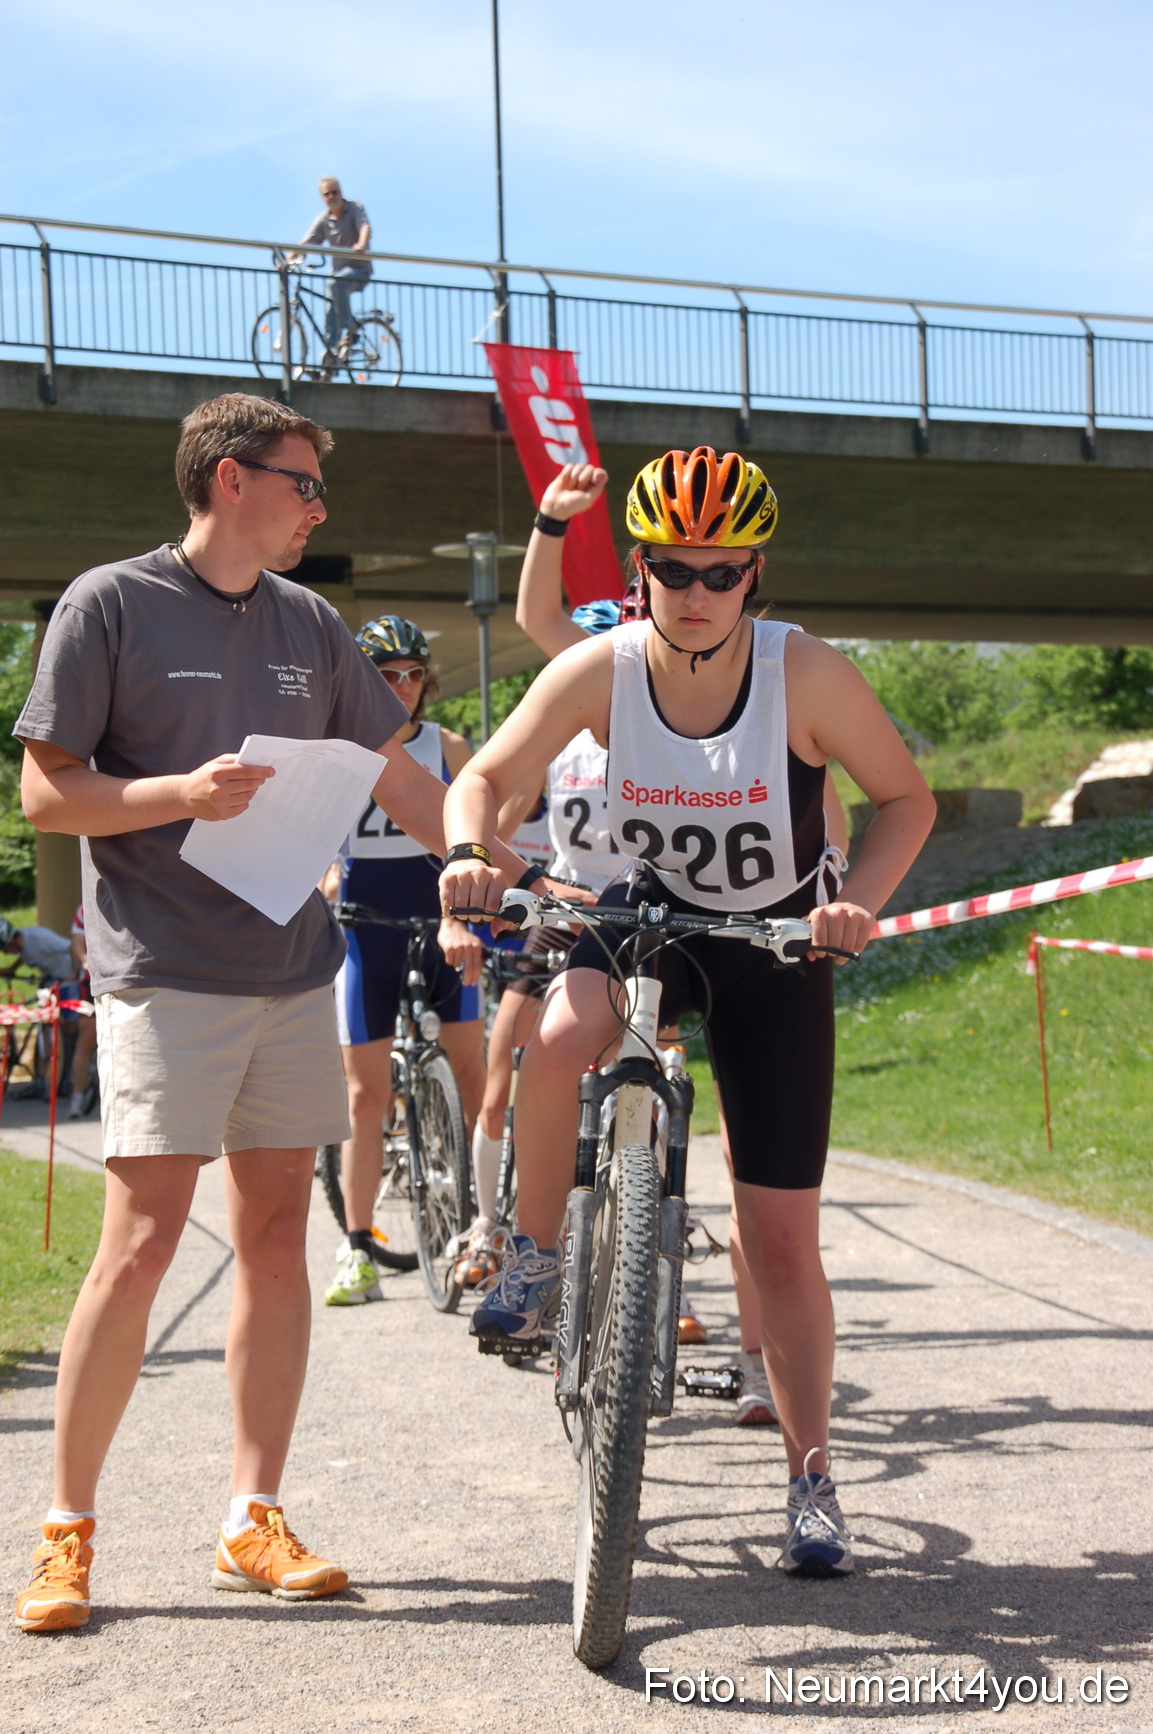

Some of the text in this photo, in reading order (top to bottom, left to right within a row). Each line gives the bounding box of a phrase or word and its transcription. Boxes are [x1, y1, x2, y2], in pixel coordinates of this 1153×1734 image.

[563, 774, 606, 789] Spark
[620, 779, 743, 808] Sparkasse
[621, 818, 775, 894] 226
